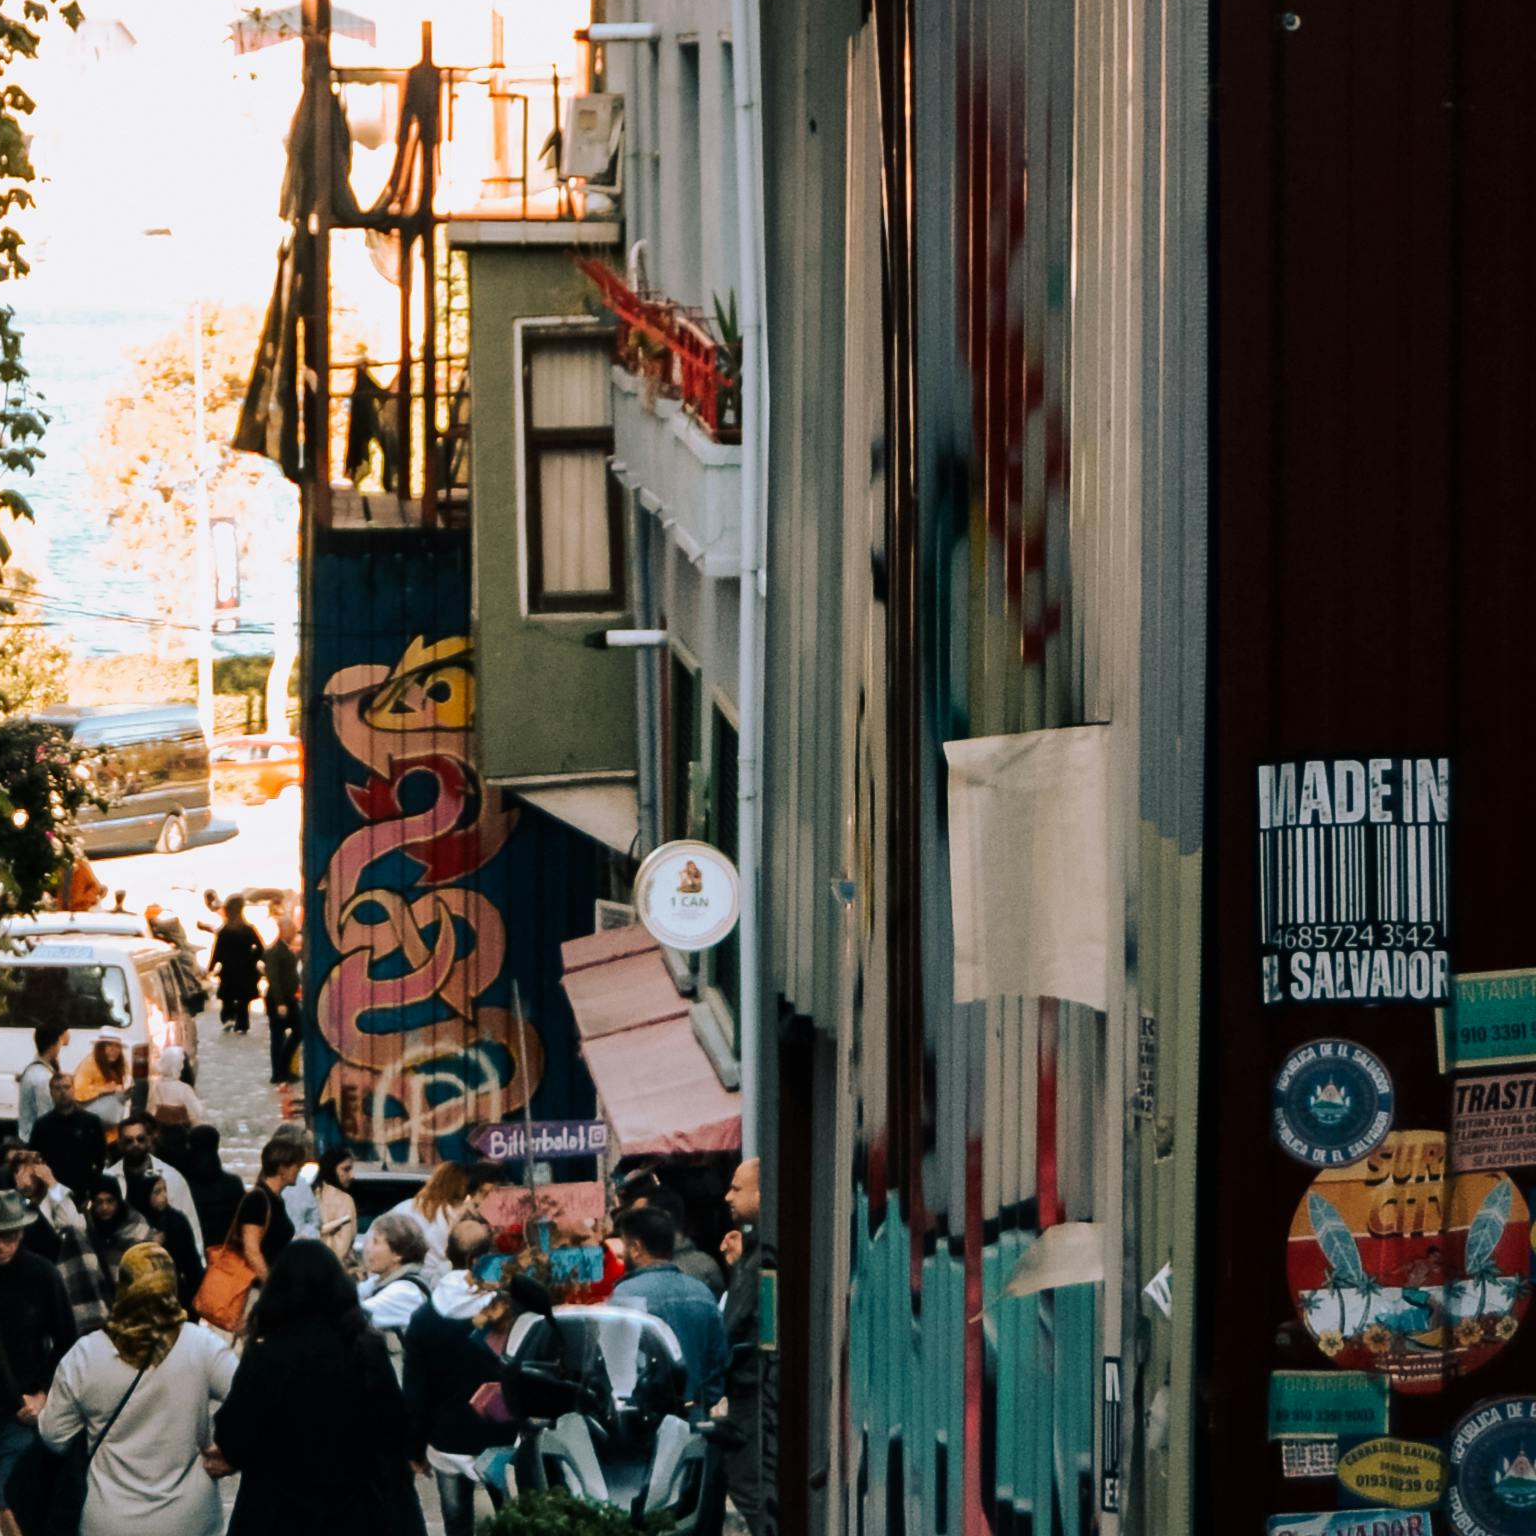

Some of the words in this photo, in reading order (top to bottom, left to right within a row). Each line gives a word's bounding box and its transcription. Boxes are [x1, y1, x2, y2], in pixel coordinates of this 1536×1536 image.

[1258, 758, 1393, 829] MADE
[1402, 758, 1449, 824] IN
[681, 896, 710, 907] CAN
[1290, 950, 1449, 1000] SALVADOR
[1319, 1043, 1333, 1056] DE
[1337, 1044, 1349, 1057] EL
[1312, 1148, 1326, 1162] DE
[1332, 1149, 1344, 1162] EL
[1505, 1402, 1523, 1419] DE
